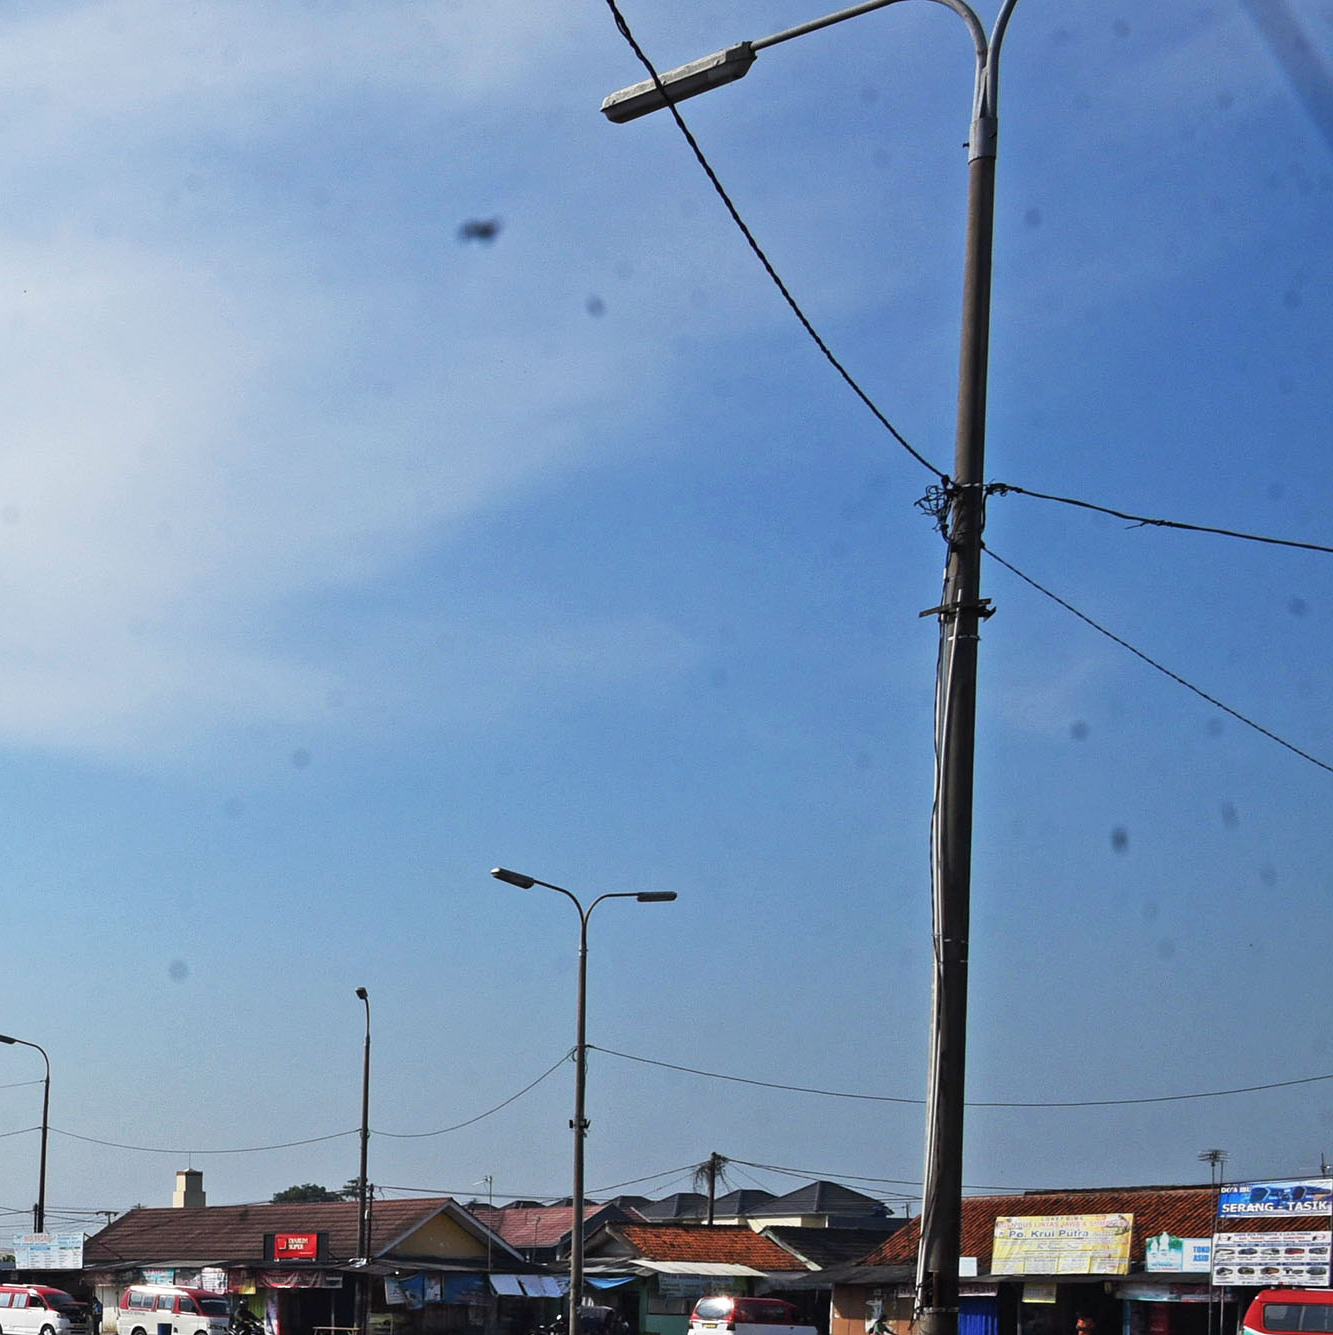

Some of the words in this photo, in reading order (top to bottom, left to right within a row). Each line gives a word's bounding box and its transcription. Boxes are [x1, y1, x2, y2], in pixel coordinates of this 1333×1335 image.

[1222, 1202, 1275, 1213] SERANG
[1287, 1200, 1328, 1212] TASIK
[1030, 1230, 1055, 1238] Krui
[1058, 1229, 1089, 1237] Putra
